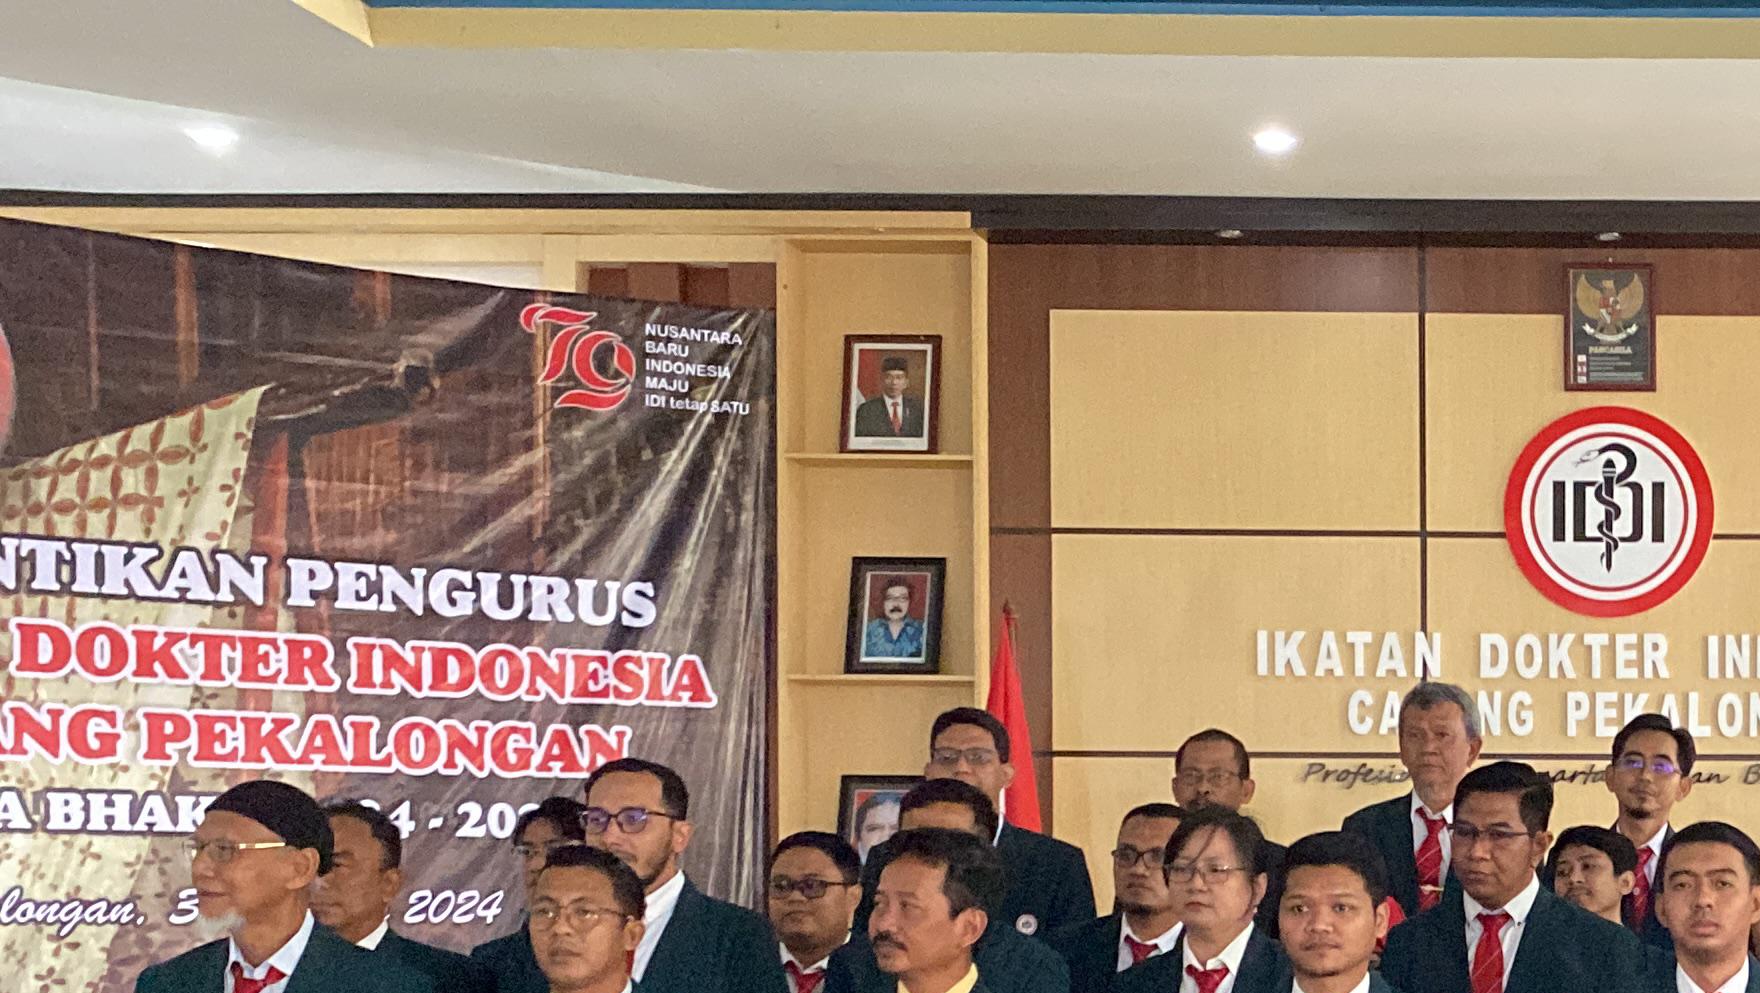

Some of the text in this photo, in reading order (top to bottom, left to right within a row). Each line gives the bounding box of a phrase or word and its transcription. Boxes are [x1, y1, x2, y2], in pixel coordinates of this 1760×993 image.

[645, 323, 742, 345] NUSANTARA
[645, 340, 689, 358] BARU
[645, 358, 731, 379] INDONESIA
[645, 376, 689, 393] MAJU
[645, 393, 750, 415] IDI tetap SATU
[287, 557, 658, 628] PENGURUS
[11, 619, 717, 707] DOKTER INDONESIA
[1256, 629, 1442, 679] IKATAN
[1479, 632, 1670, 680] DOKTER
[1348, 689, 1534, 737] CANG
[0, 701, 633, 778] NG PEKALONGAN
[46, 792, 217, 833] BHAK
[403, 889, 505, 925] 2024
